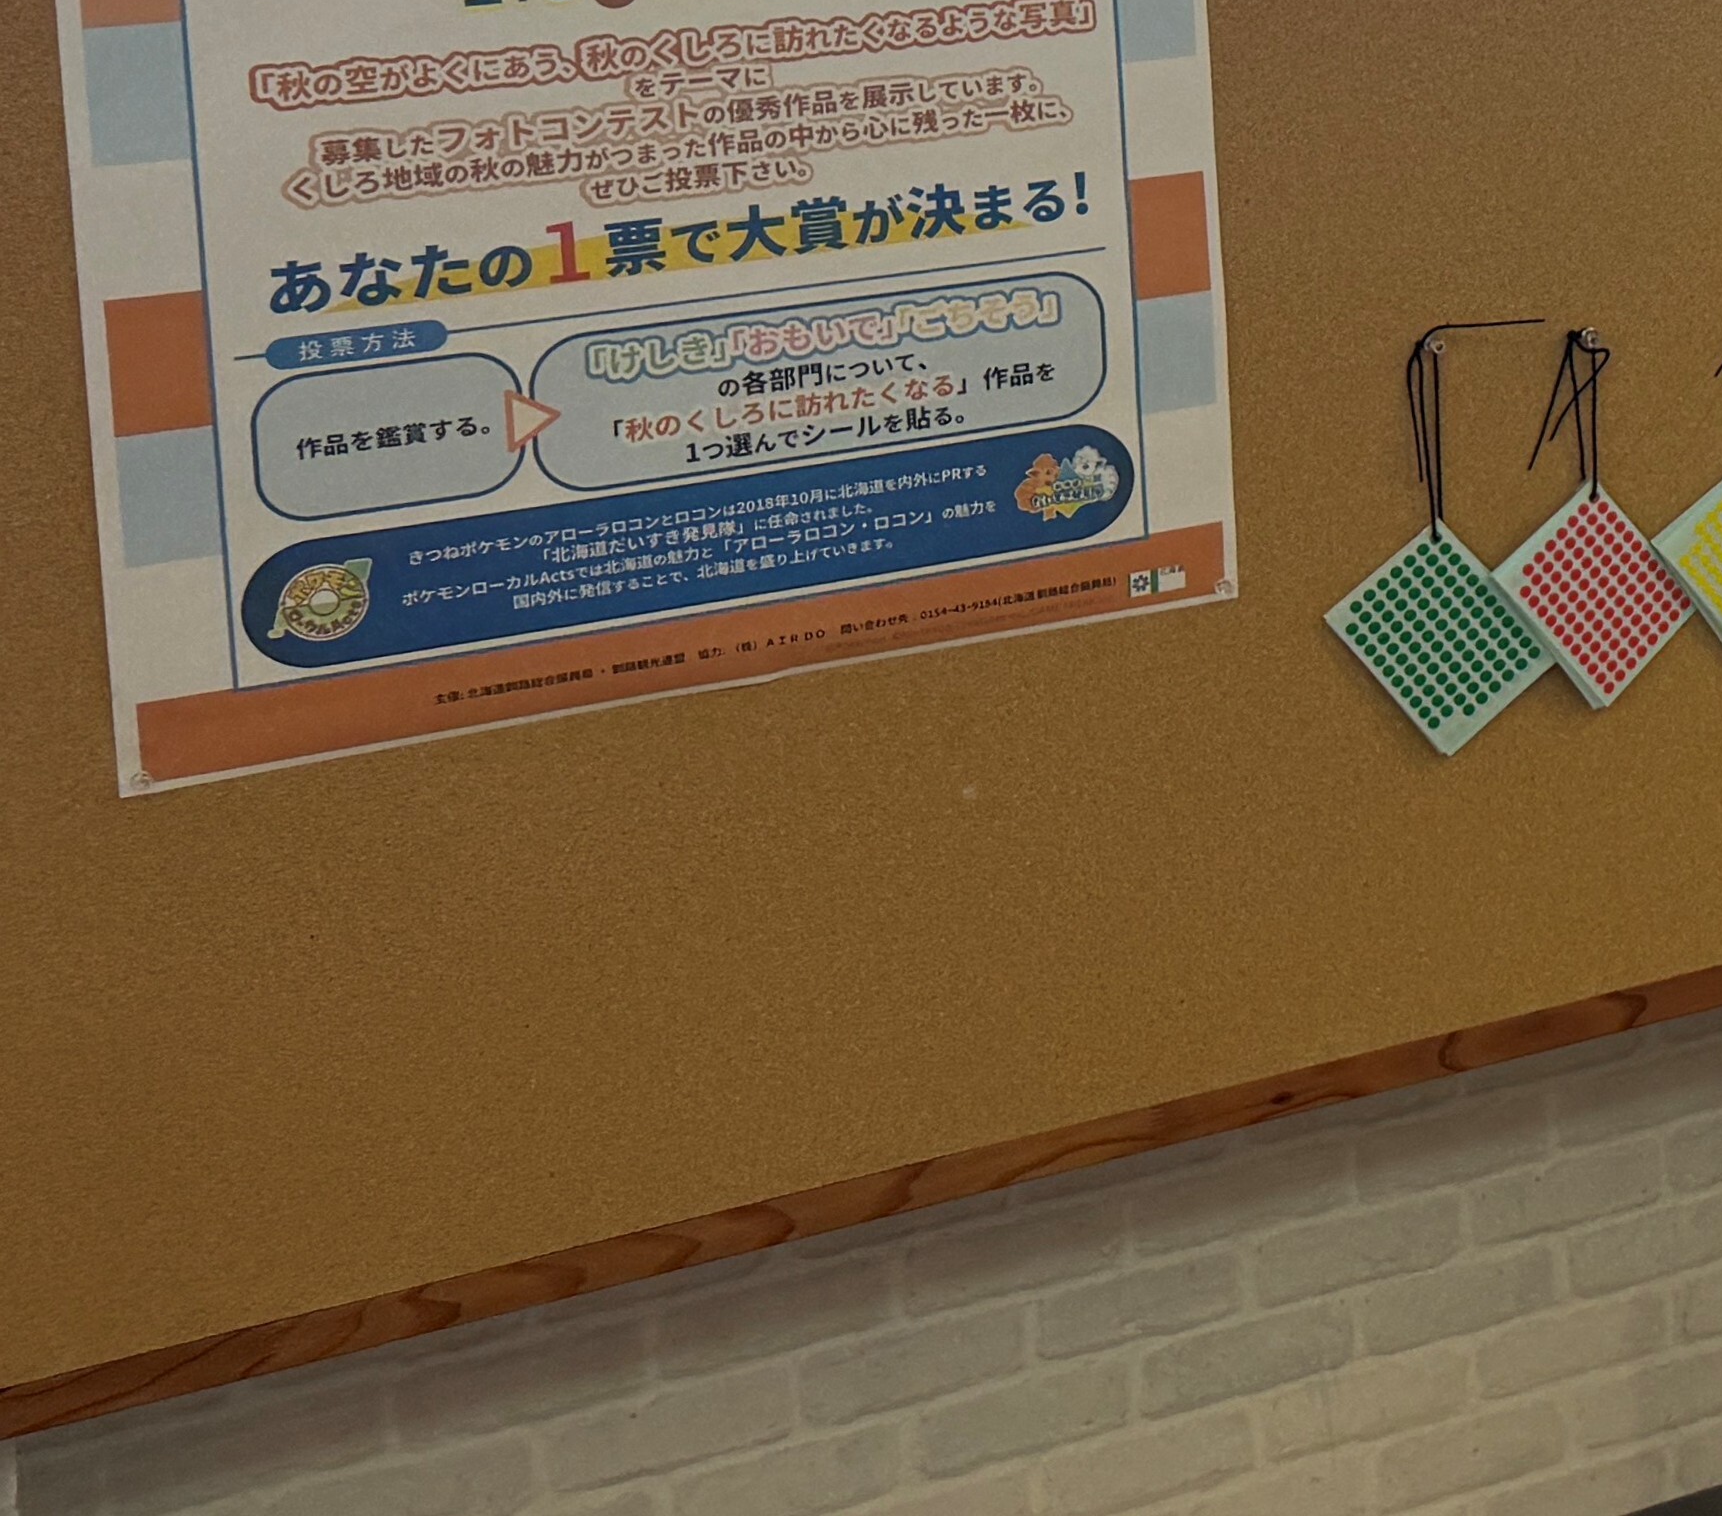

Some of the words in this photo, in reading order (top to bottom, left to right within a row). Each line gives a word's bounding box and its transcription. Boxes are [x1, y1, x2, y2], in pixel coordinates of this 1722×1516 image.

[633, 63, 769, 99] をテーマに
[319, 70, 1041, 167] 募集したフォトコンテストの優秀作品を展示しています。
[286, 98, 1070, 202] くしろ地域の秋の魅力がつまった作品の中から心に残った一枚に、
[588, 156, 809, 200] ぜひご投票下さい。
[298, 329, 417, 362] 投票方法
[717, 353, 928, 398] の各部門について、
[296, 417, 492, 461] 作品を鑑賞する。
[685, 408, 967, 464] 1つ選んでシールを貼る。
